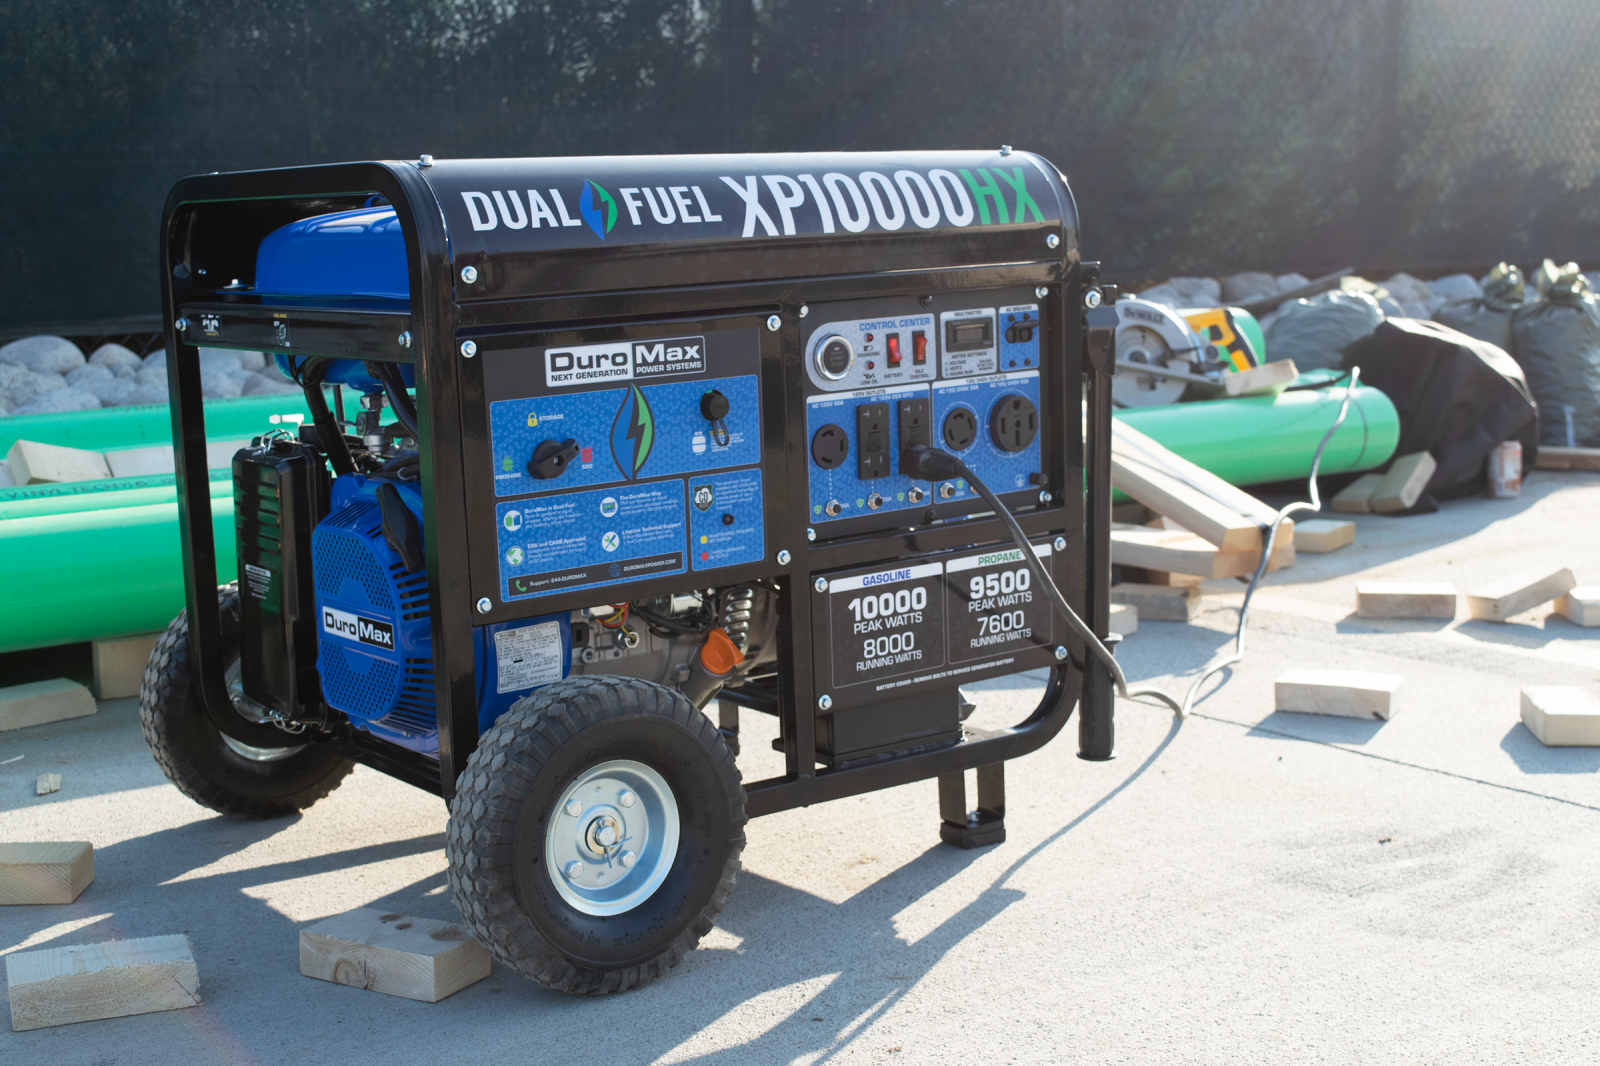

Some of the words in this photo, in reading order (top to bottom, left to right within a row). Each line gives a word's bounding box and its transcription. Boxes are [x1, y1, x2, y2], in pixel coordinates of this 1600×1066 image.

[461, 189, 582, 231] DUAL
[619, 186, 722, 225] FUEL
[718, 167, 1045, 238] XP10000HX
[859, 320, 897, 331] CONTROL
[899, 317, 930, 328] CENTER
[551, 374, 573, 382] NEXT
[576, 368, 628, 379] GENERATION
[636, 365, 664, 374] POWER
[666, 361, 701, 371] SYSTEMS
[852, 390, 865, 398] 120V
[496, 472, 522, 480] PROPANE
[699, 491, 708, 502] CO
[524, 506, 547, 514] DuroMax
[663, 522, 682, 530] Support
[623, 559, 676, 572] DUROMAXPOWER.COM
[978, 551, 1021, 566] PROPANE
[551, 573, 587, 583] 844-DUROMAX
[863, 569, 911, 586] GASOLINE
[970, 568, 1031, 600] 9500
[848, 586, 927, 621] 10000
[968, 597, 996, 613] PEAK
[997, 591, 1032, 608] WATTS
[325, 611, 392, 645] DuroMax
[854, 618, 883, 635] PEAK
[885, 611, 923, 629] WATTS
[977, 610, 1025, 636] 7600
[864, 631, 914, 659] 8000
[970, 633, 1005, 648] RUNNING
[1006, 628, 1032, 642] WATTS
[856, 655, 894, 672] RUNNING
[894, 649, 922, 664] WATTS
[876, 682, 895, 691] BATTERY
[896, 679, 911, 687] COVER
[913, 675, 932, 683] REMOVE
[932, 672, 946, 680] BOLTS
[952, 666, 970, 675] SERVICE
[971, 661, 996, 671] GENERATOR
[996, 657, 1014, 666] BATTERY
[650, 916, 668, 936] LOAD
[570, 927, 584, 942] FOR
[587, 933, 601, 946] NOT
